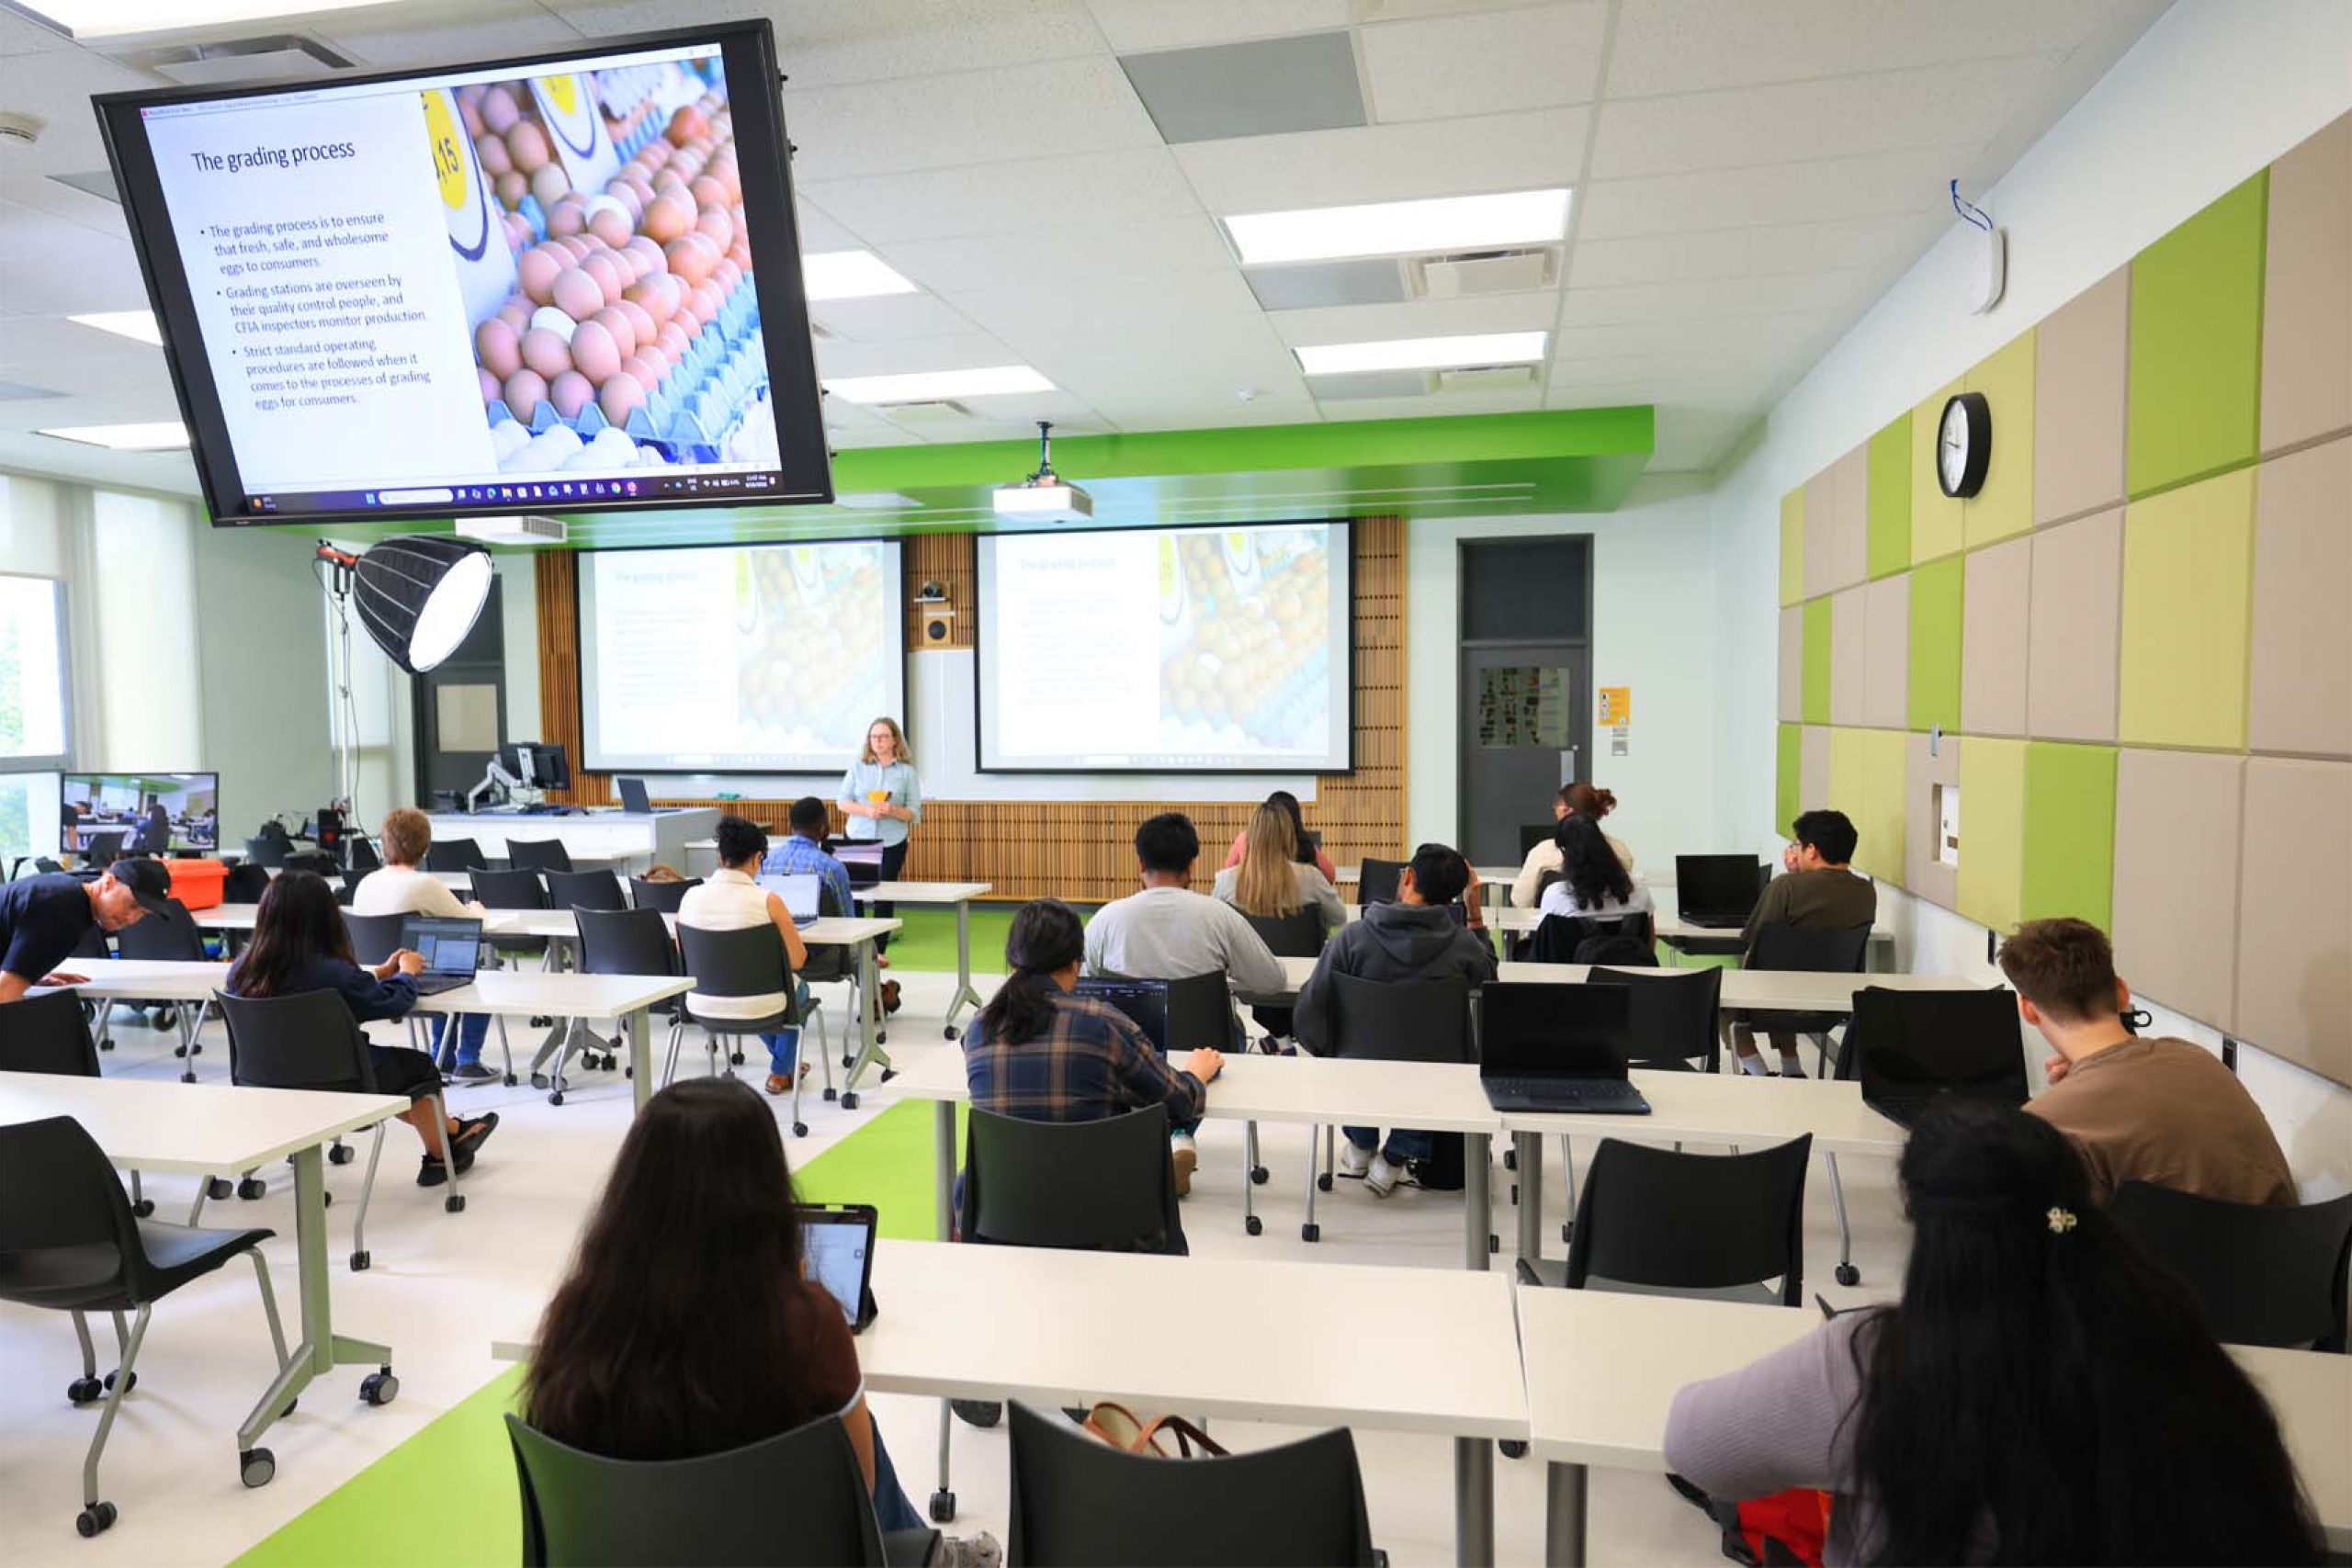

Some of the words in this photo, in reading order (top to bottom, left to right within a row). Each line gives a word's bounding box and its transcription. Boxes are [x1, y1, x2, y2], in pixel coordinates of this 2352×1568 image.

[191, 152, 224, 172] The
[227, 145, 289, 173] grading
[291, 141, 356, 167] process
[209, 224, 230, 238] The
[232, 221, 275, 239] grading
[276, 219, 318, 235] process
[320, 217, 330, 229] is
[332, 216, 344, 228] to
[346, 213, 384, 226] ensure
[214, 243, 237, 256] that
[239, 240, 270, 254] fresh,
[273, 237, 299, 252] safe,
[301, 235, 322, 249] and
[324, 231, 389, 247] wholesome
[220, 262, 244, 276] eggs
[246, 260, 258, 273] to
[226, 286, 268, 300] Grading
[270, 281, 313, 296] stations
[315, 280, 333, 292] are
[334, 277, 386, 291] overseen
[388, 274, 401, 288] by
[231, 303, 255, 317] their
[259, 300, 295, 317] quality
[297, 298, 335, 312] control
[338, 295, 380, 310] people,
[382, 292, 403, 305] and
[234, 320, 261, 334] CFIA
[262, 317, 316, 333] inspectors
[318, 314, 361, 329] monitor
[243, 344, 272, 359] Strict
[275, 341, 321, 355] standard
[323, 338, 378, 355] operating
[245, 362, 305, 378] procedures
[308, 360, 325, 372] are
[327, 354, 374, 369] followed
[377, 353, 408, 367] when
[410, 353, 418, 365] it
[251, 381, 285, 393] comes
[287, 379, 298, 391] to
[300, 377, 318, 389] the
[321, 375, 374, 389] processes
[376, 372, 387, 385] of
[390, 370, 431, 386] grading
[254, 399, 279, 412] eggs
[281, 395, 297, 408] for
